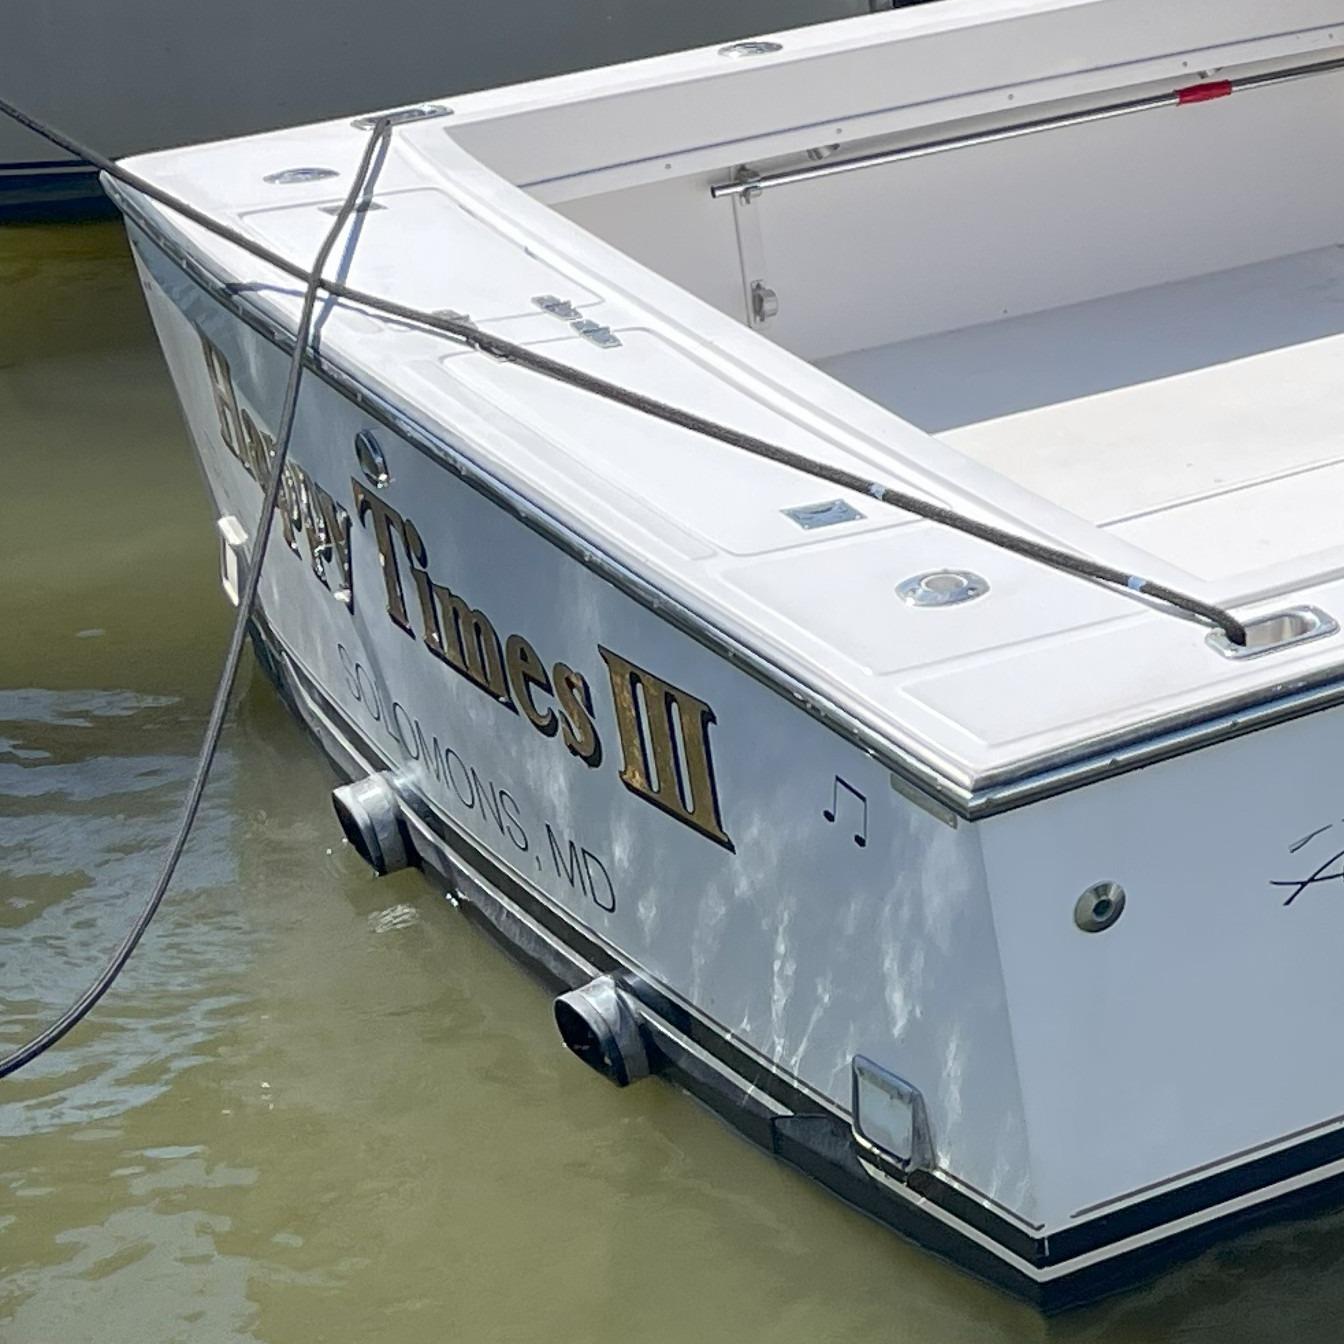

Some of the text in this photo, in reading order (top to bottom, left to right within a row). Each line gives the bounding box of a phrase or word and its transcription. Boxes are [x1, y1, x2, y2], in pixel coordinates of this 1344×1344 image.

[351, 475, 603, 769] Times
[597, 643, 737, 855] III
[545, 822, 617, 914] MD
